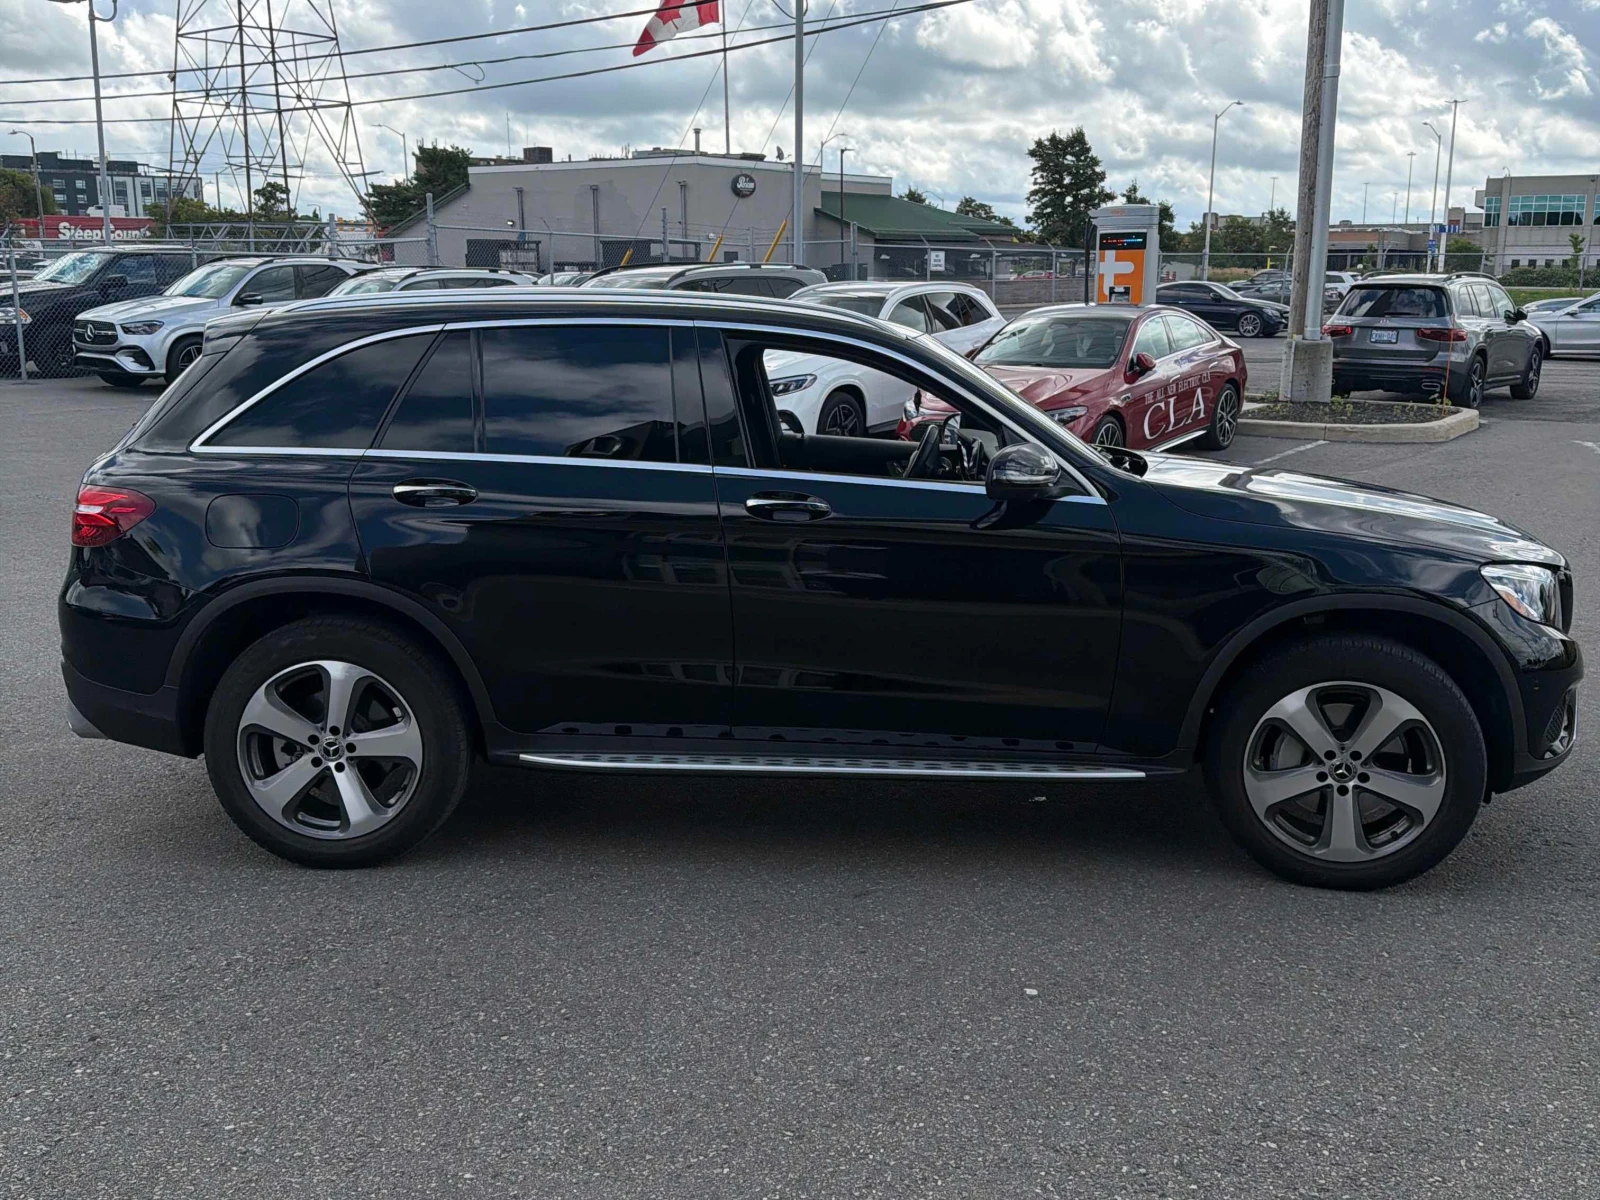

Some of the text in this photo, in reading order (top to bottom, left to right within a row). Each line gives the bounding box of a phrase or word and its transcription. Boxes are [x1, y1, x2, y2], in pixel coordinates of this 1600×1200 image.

[1144, 371, 1211, 405] THE ALL NEW ELECTRIC CLA
[1143, 387, 1206, 440] CLA
